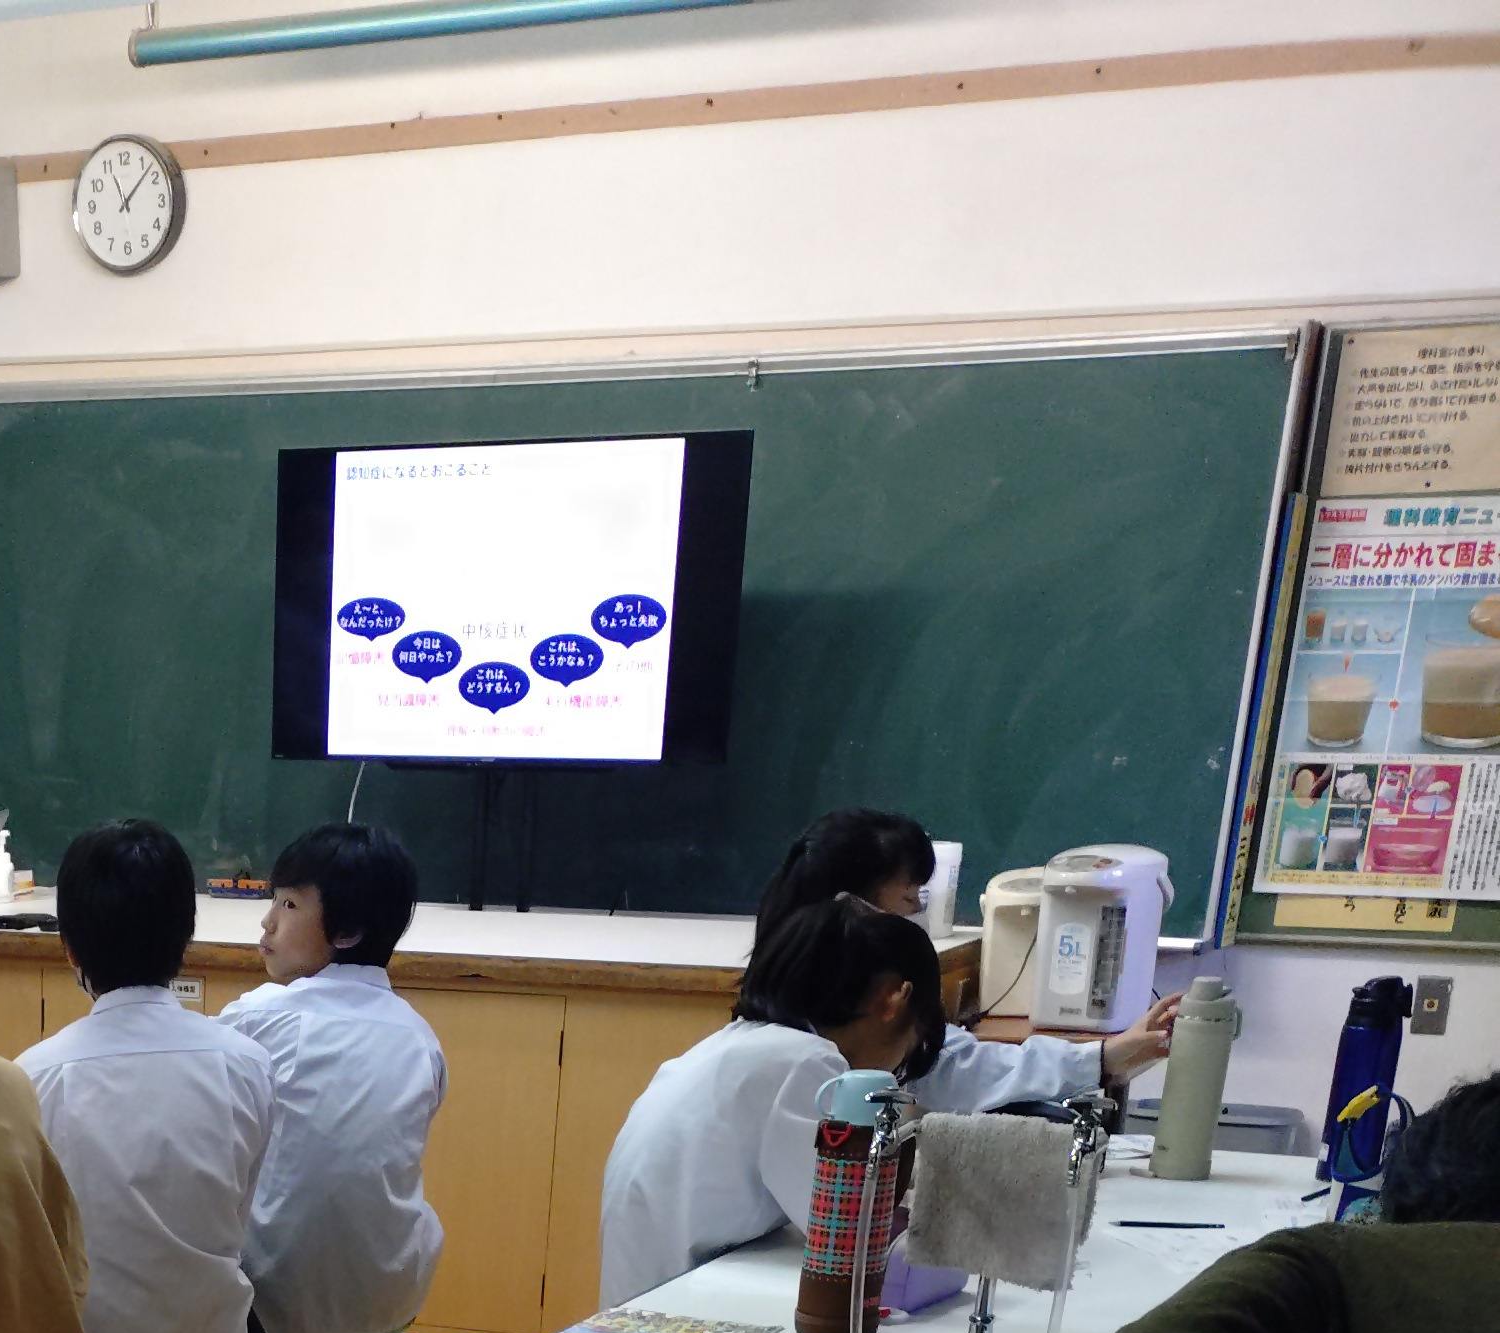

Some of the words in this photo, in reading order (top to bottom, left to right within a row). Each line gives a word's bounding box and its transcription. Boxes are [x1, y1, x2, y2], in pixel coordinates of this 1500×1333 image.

[117, 151, 130, 165] 12
[139, 156, 144, 170] 1
[103, 160, 112, 174] 11
[91, 178, 104, 192] 10
[151, 171, 159, 185] 2
[88, 200, 96, 214] 9
[158, 194, 165, 208] 3
[94, 221, 102, 235] 8
[153, 218, 161, 231] 4
[108, 238, 114, 251] 7
[124, 242, 132, 255] 6
[141, 235, 149, 248] 5
[347, 463, 490, 480] 認知症になるとおこること
[1383, 506, 1500, 527] 理科教育ニュ
[1310, 541, 1500, 570] 二層に分かれて固ま
[599, 615, 658, 628] ちょっと失敗
[413, 637, 440, 649] 今日は
[399, 651, 453, 664] 何日やった？
[466, 681, 521, 694] どうするん？
